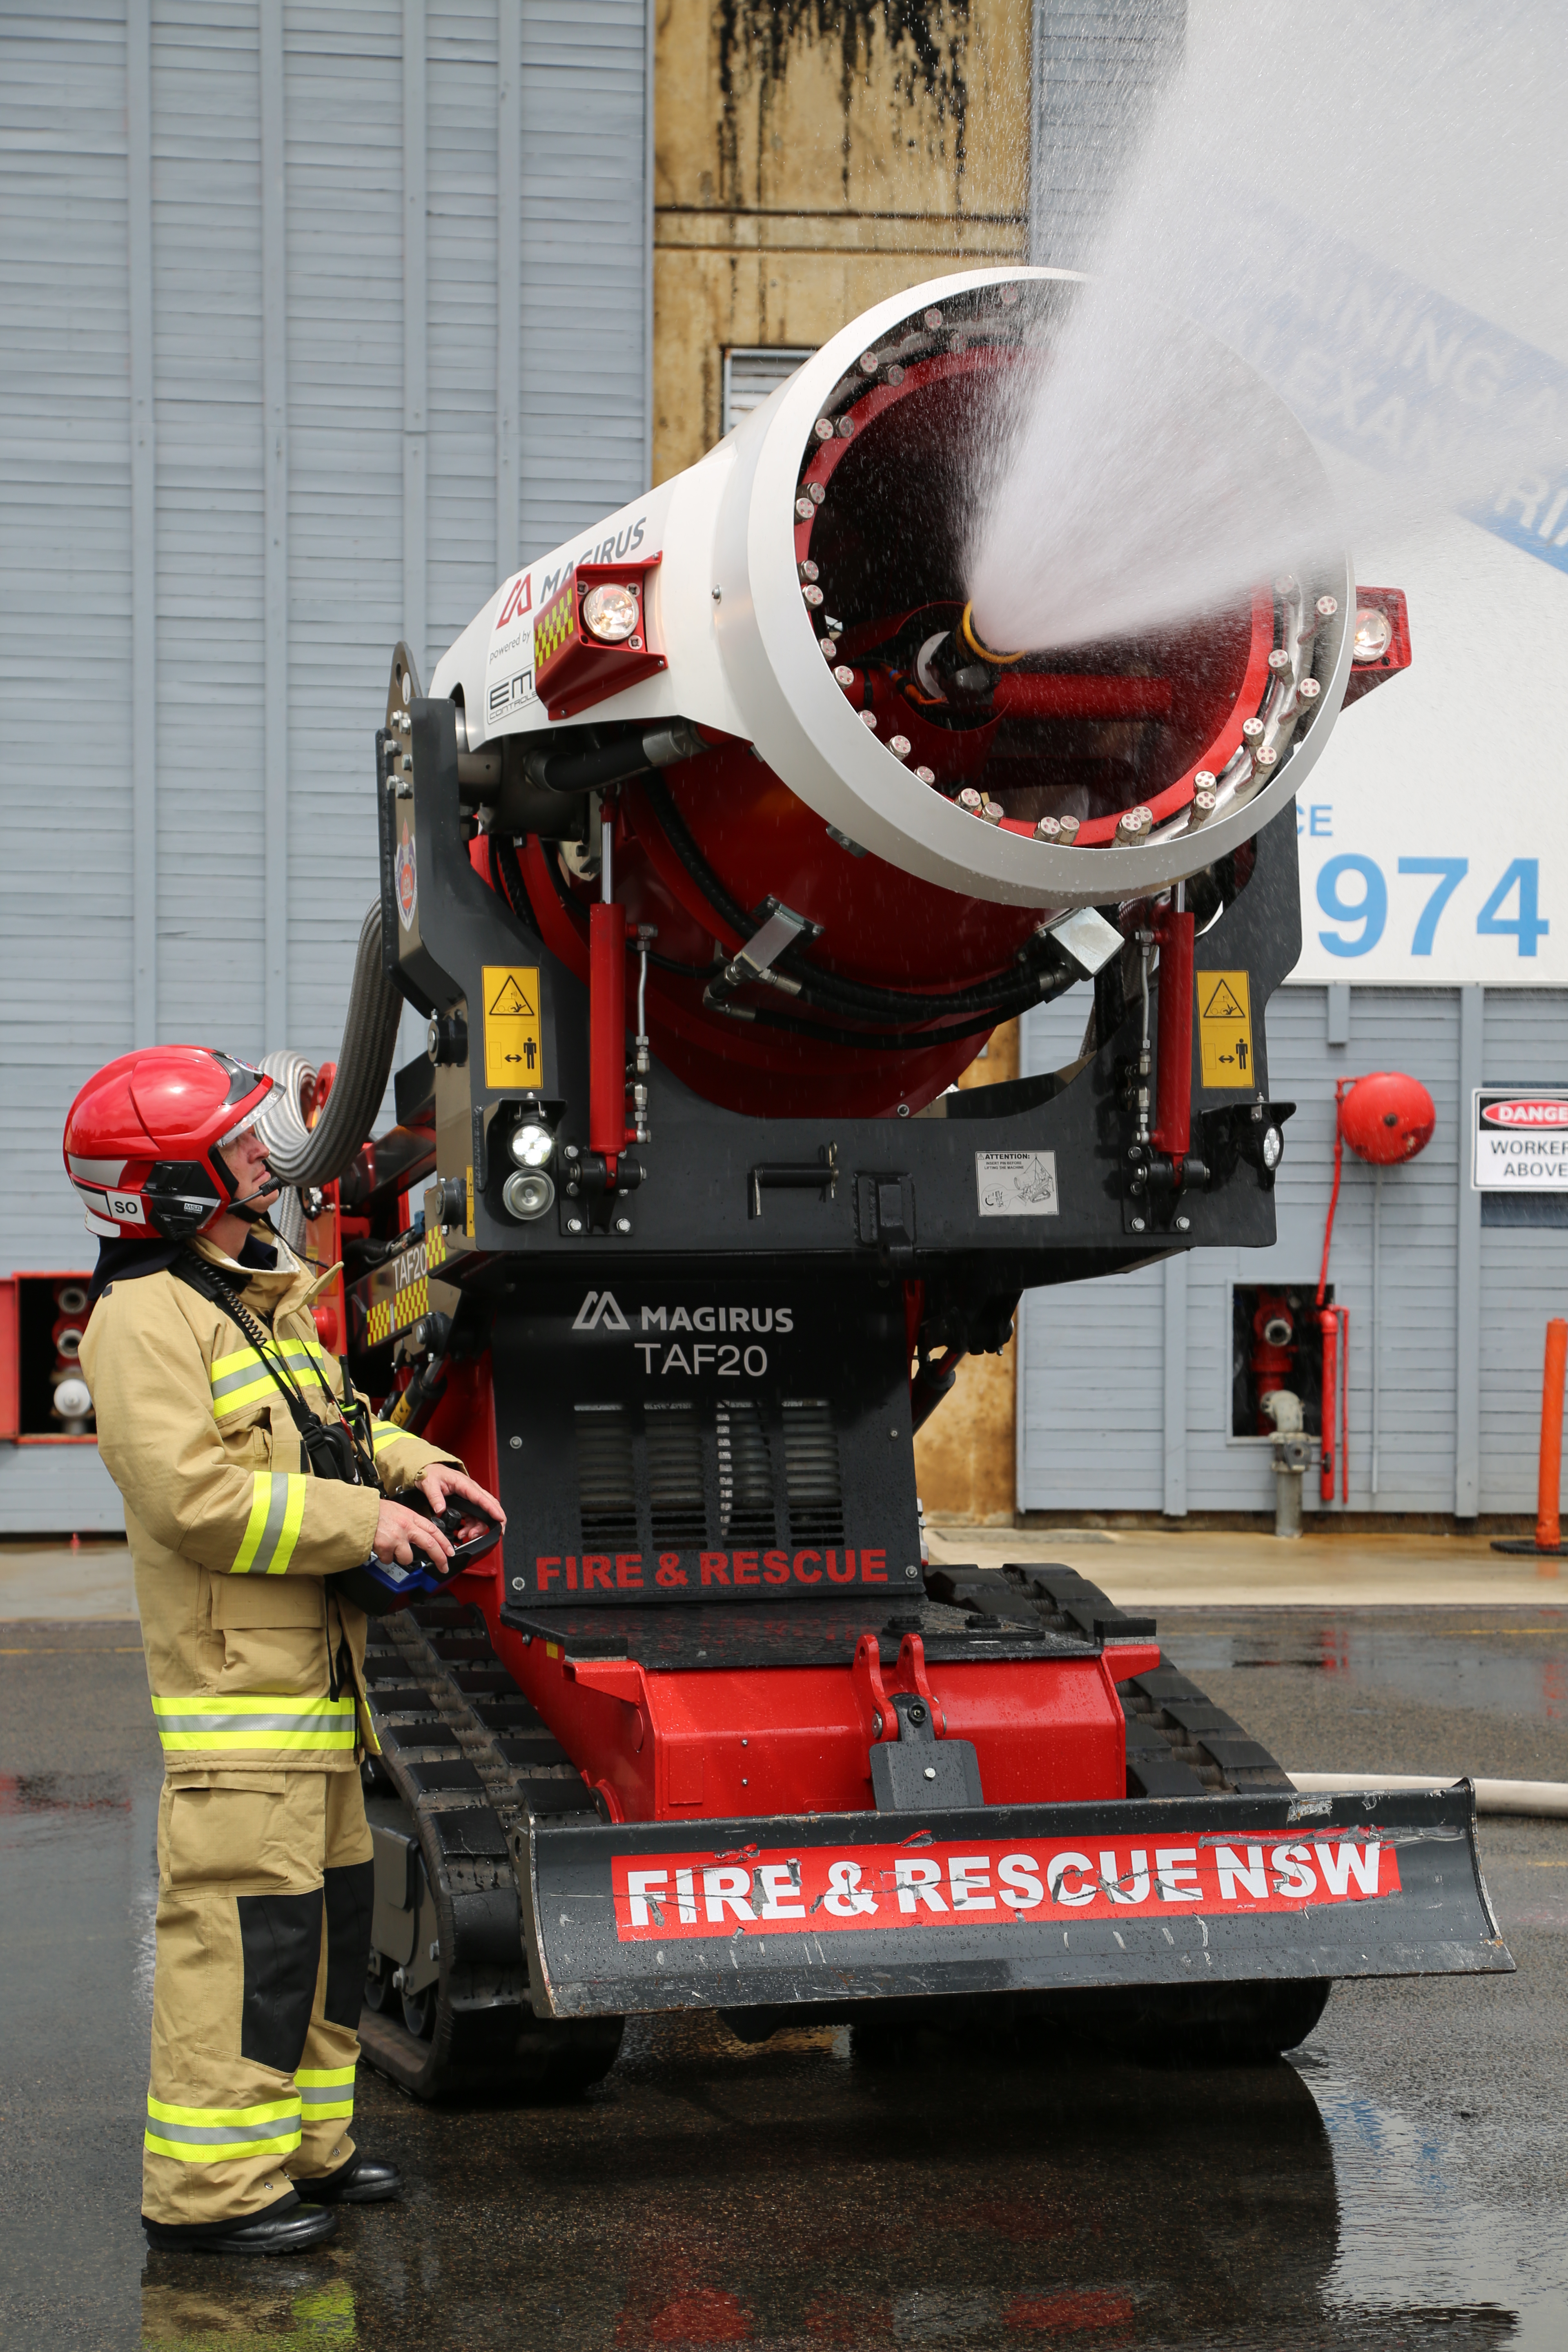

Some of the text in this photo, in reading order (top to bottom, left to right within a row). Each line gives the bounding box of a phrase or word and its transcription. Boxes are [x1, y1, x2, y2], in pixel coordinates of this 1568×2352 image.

[489, 630, 531, 664] powered by
[1316, 853, 1550, 958] 974
[1499, 1106, 1568, 1121] DANGE
[1503, 1162, 1568, 1176] ABOVE
[114, 1201, 138, 1214] SO
[392, 1243, 427, 1291] TAF20
[641, 1306, 793, 1332] MAGIRUS
[635, 1343, 768, 1376] TAF20
[536, 1549, 889, 1591] FIRE & RESCUE
[627, 1842, 1381, 1927] FIRE & RESCUE NSW
